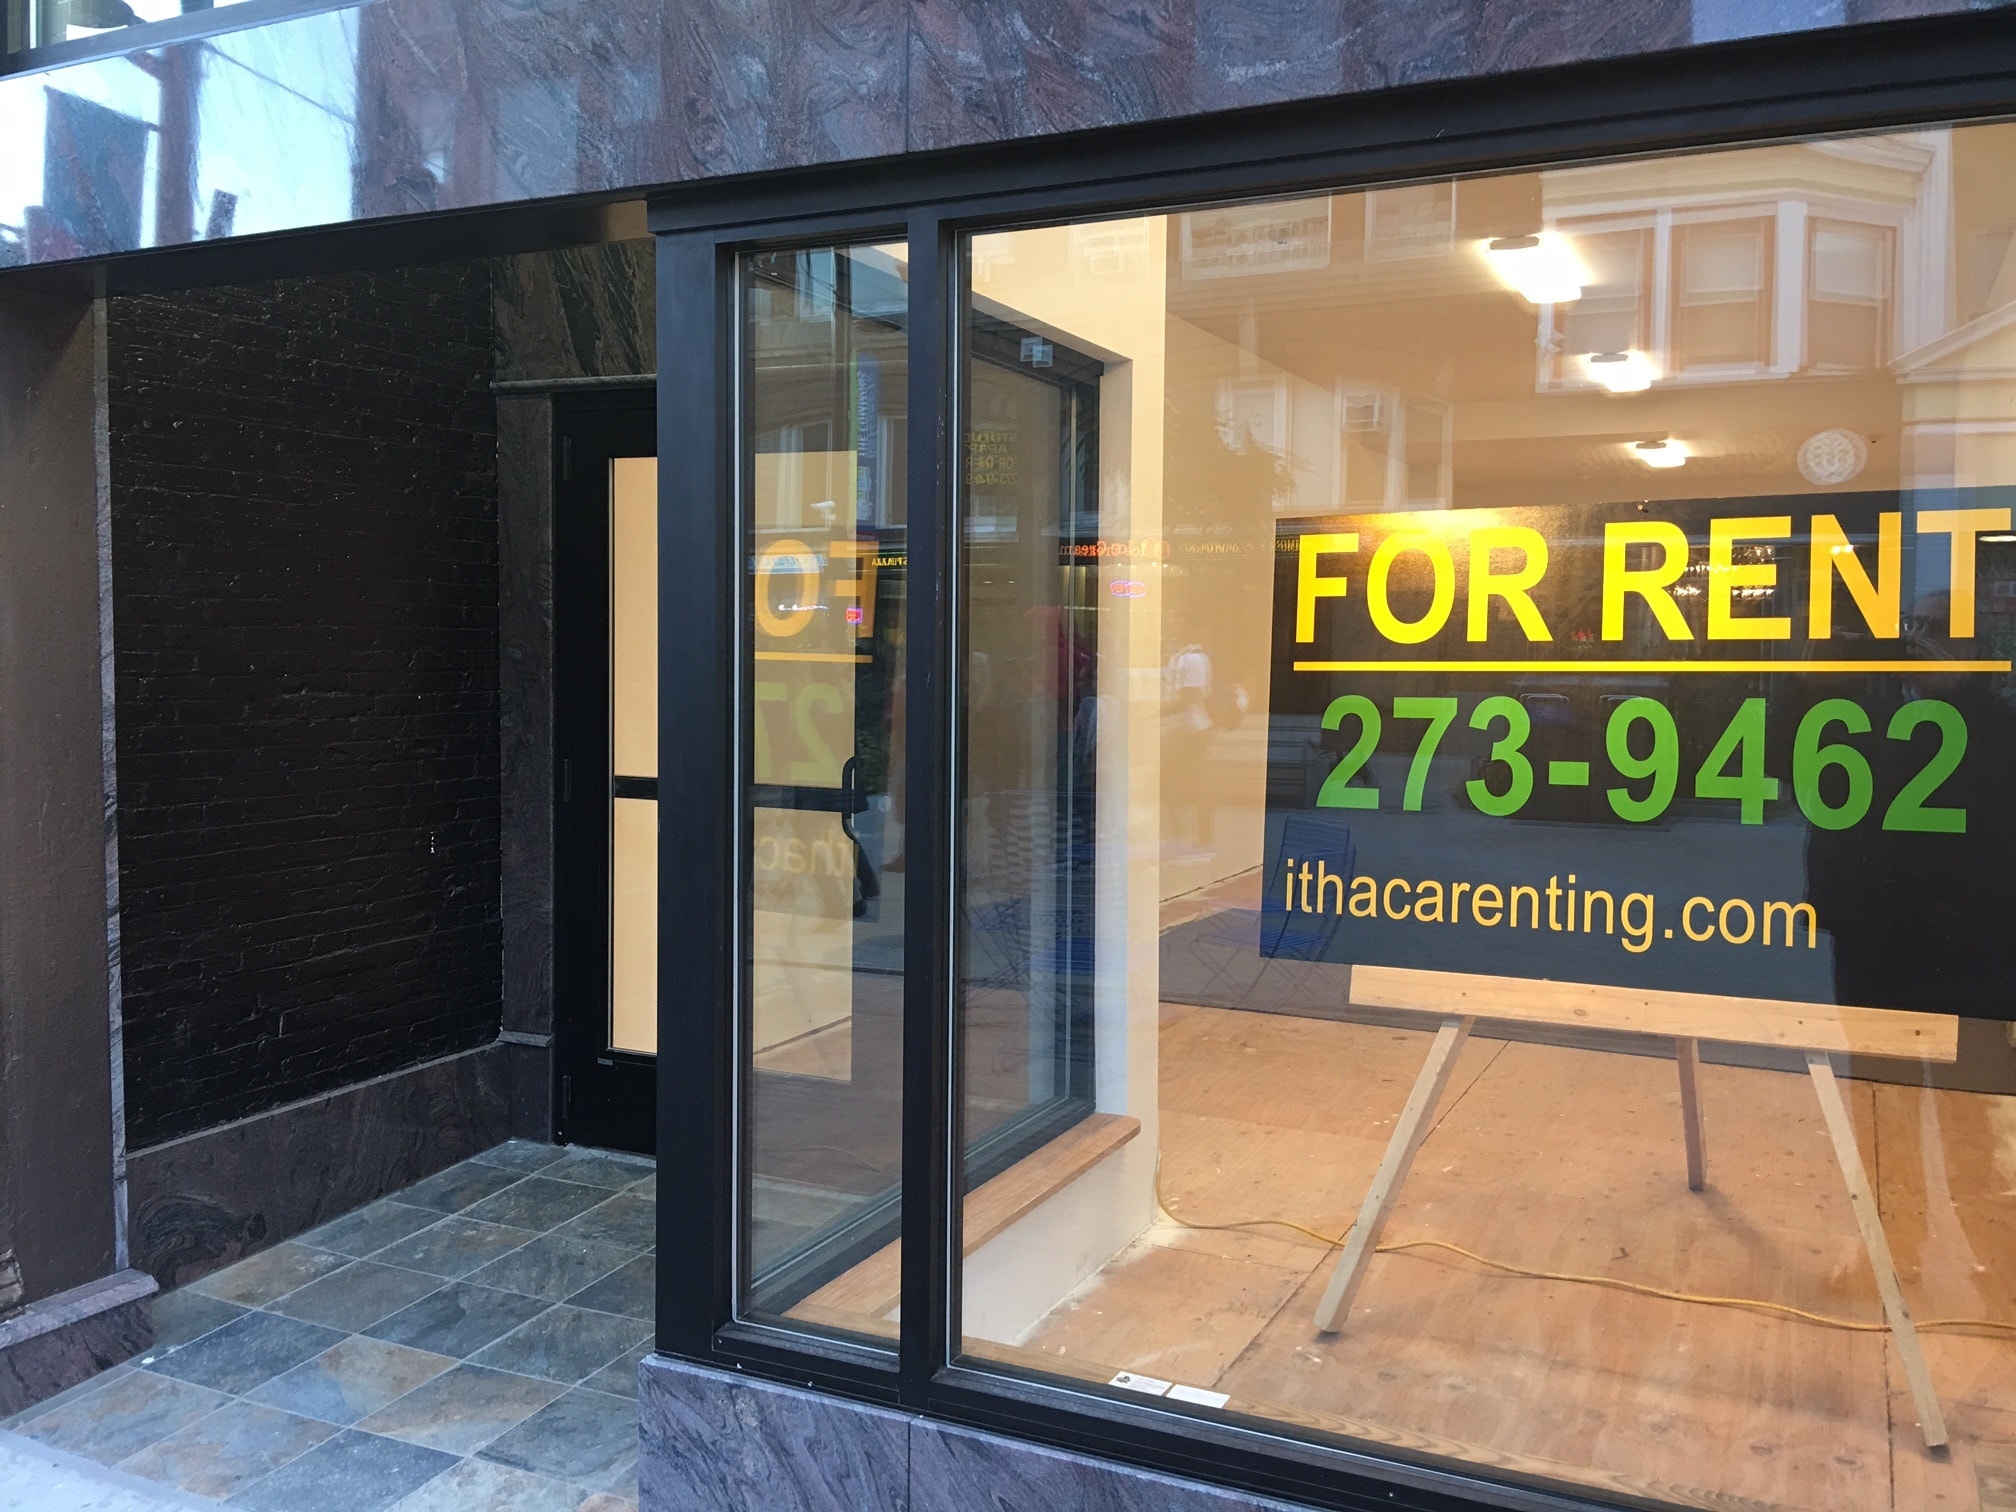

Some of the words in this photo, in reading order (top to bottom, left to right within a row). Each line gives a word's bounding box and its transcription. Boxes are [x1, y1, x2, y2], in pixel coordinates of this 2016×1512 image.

[1294, 526, 1554, 644] FOR
[1602, 508, 2012, 642] RENT
[1315, 694, 1968, 834] 273-9462
[1285, 859, 1818, 954] ithacarenting.com
